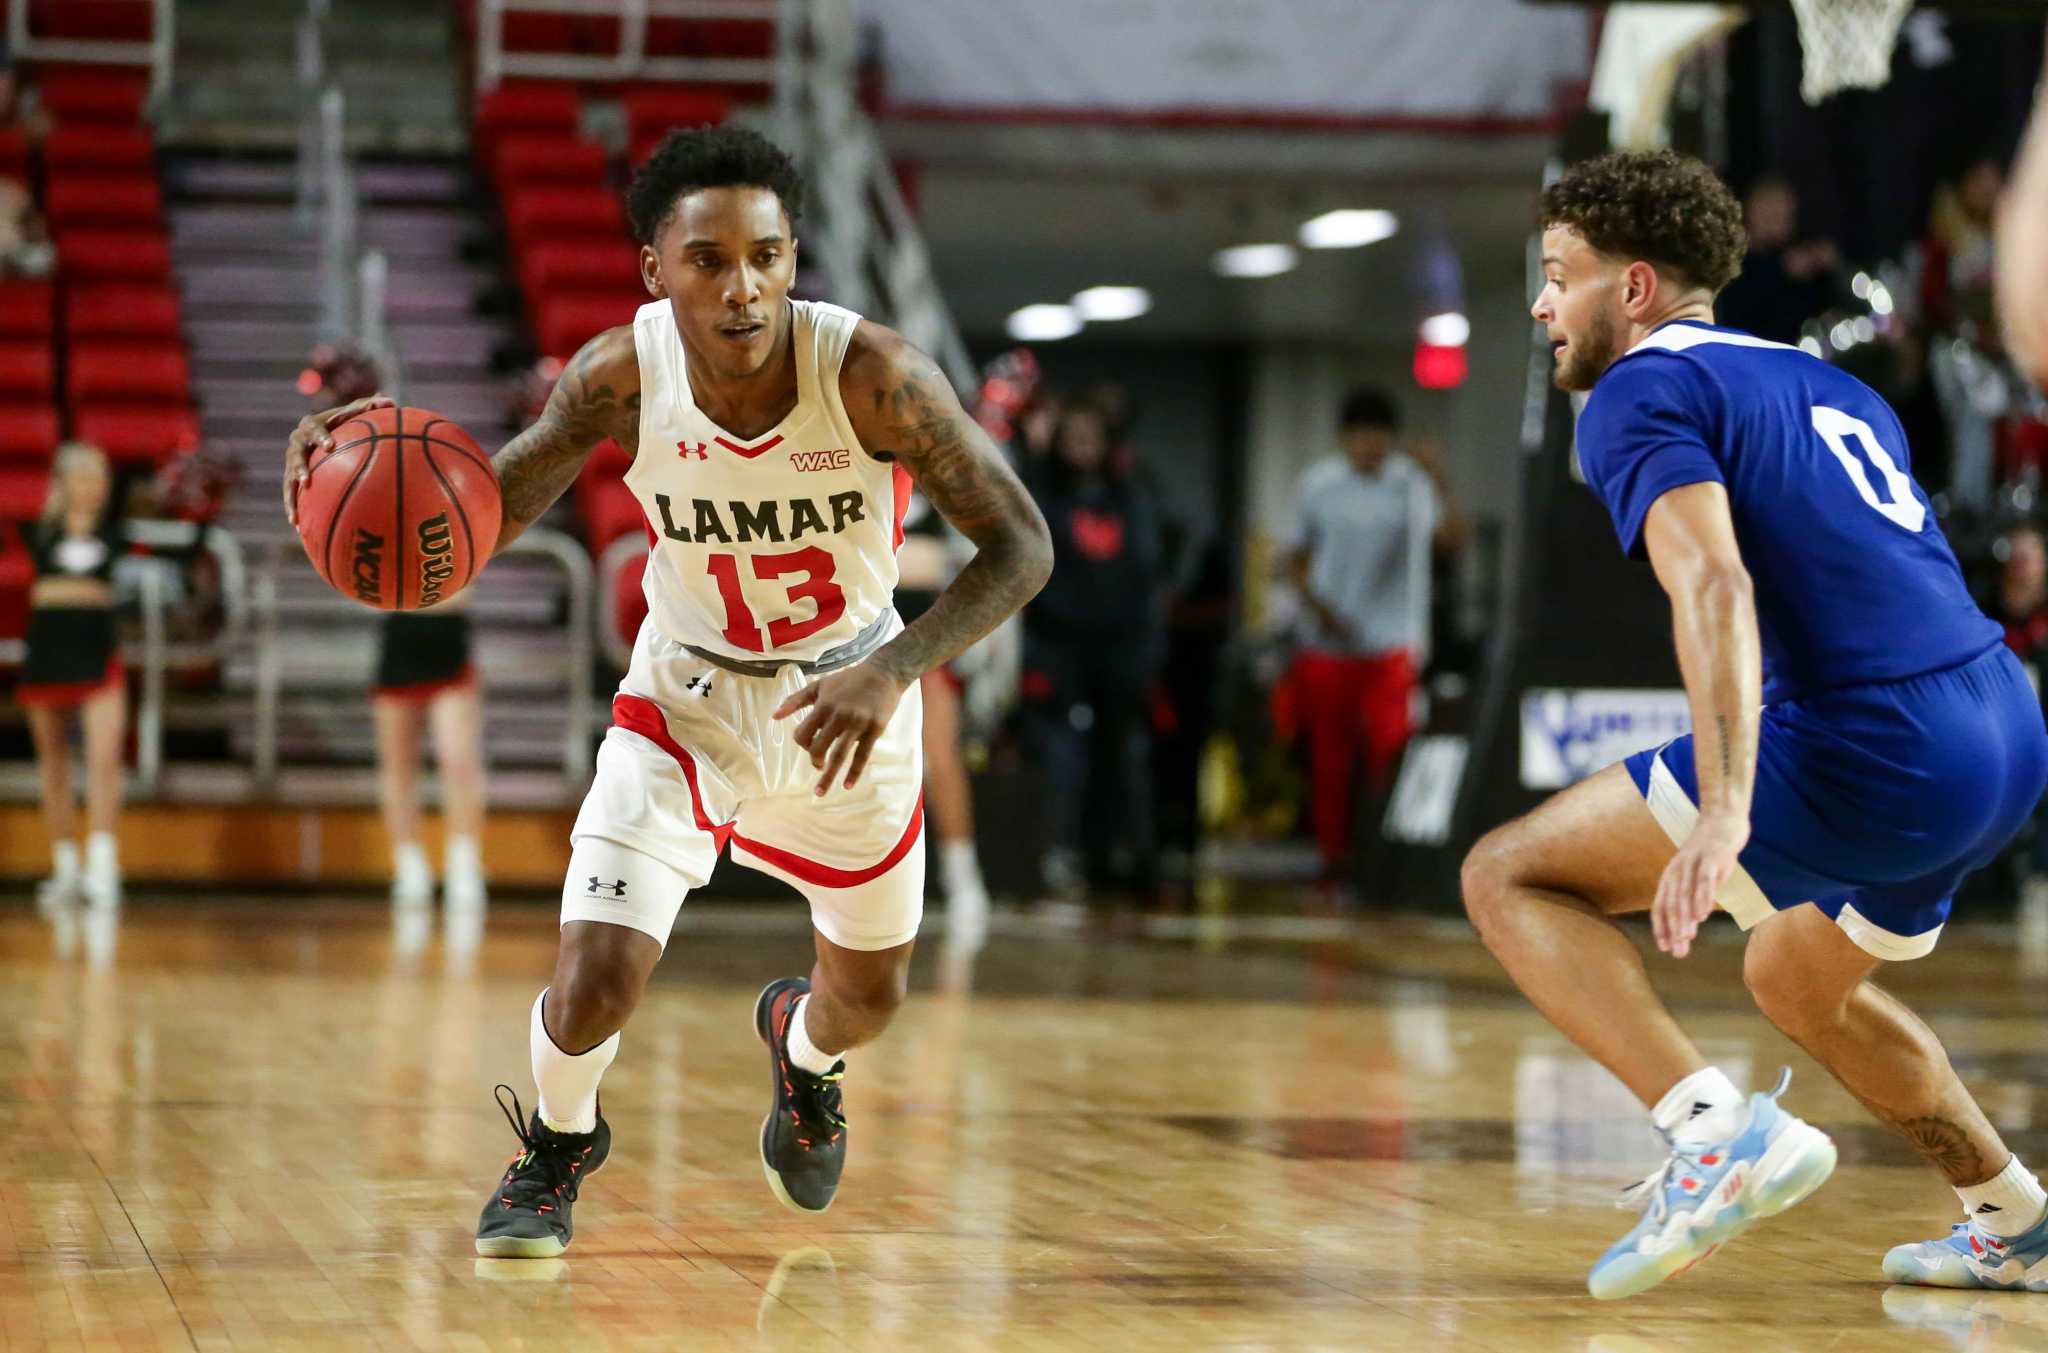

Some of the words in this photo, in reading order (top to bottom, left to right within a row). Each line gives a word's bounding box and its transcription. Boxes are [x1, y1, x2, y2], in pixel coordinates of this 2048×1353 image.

[789, 449, 850, 472] WAC
[1810, 405, 1926, 533] 0
[655, 490, 865, 543] LAMAR
[706, 545, 846, 653] 13
